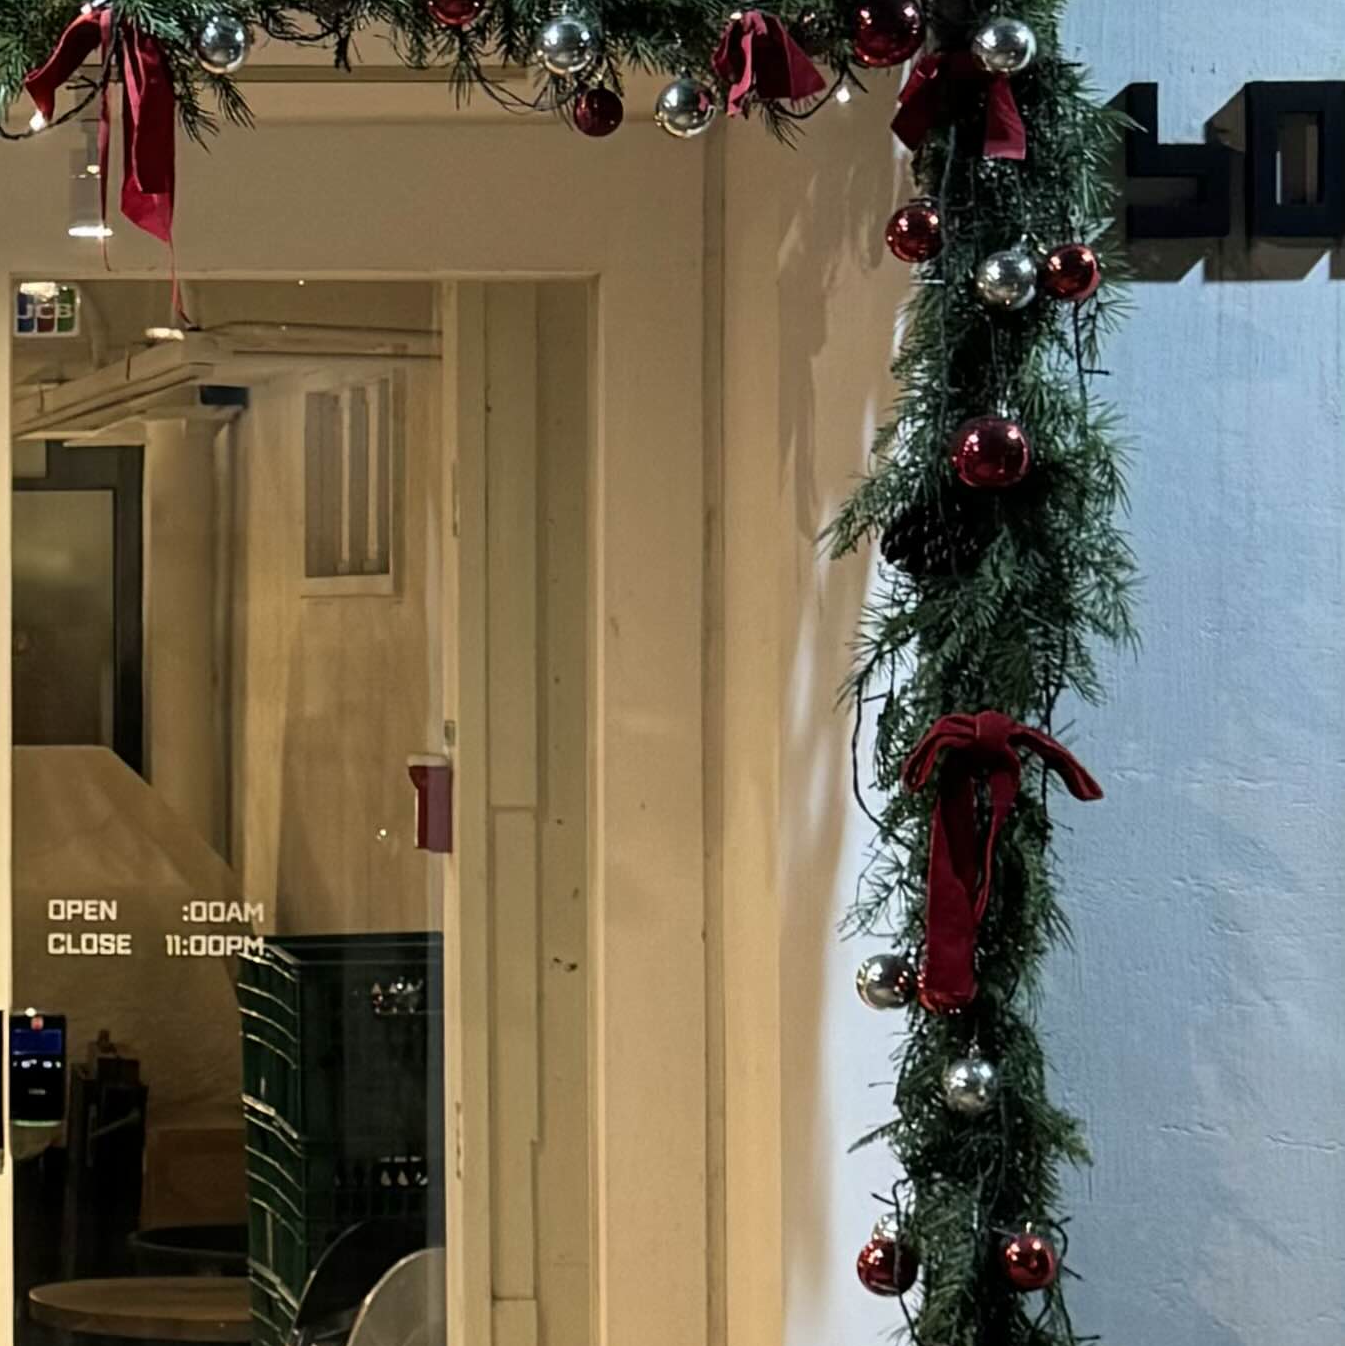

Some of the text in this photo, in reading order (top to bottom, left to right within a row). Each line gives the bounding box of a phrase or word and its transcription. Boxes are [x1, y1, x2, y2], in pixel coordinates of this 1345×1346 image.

[16, 303, 75, 319] JCB
[48, 899, 117, 921] OPEN
[48, 933, 265, 957] CLOSE 11:00PM
